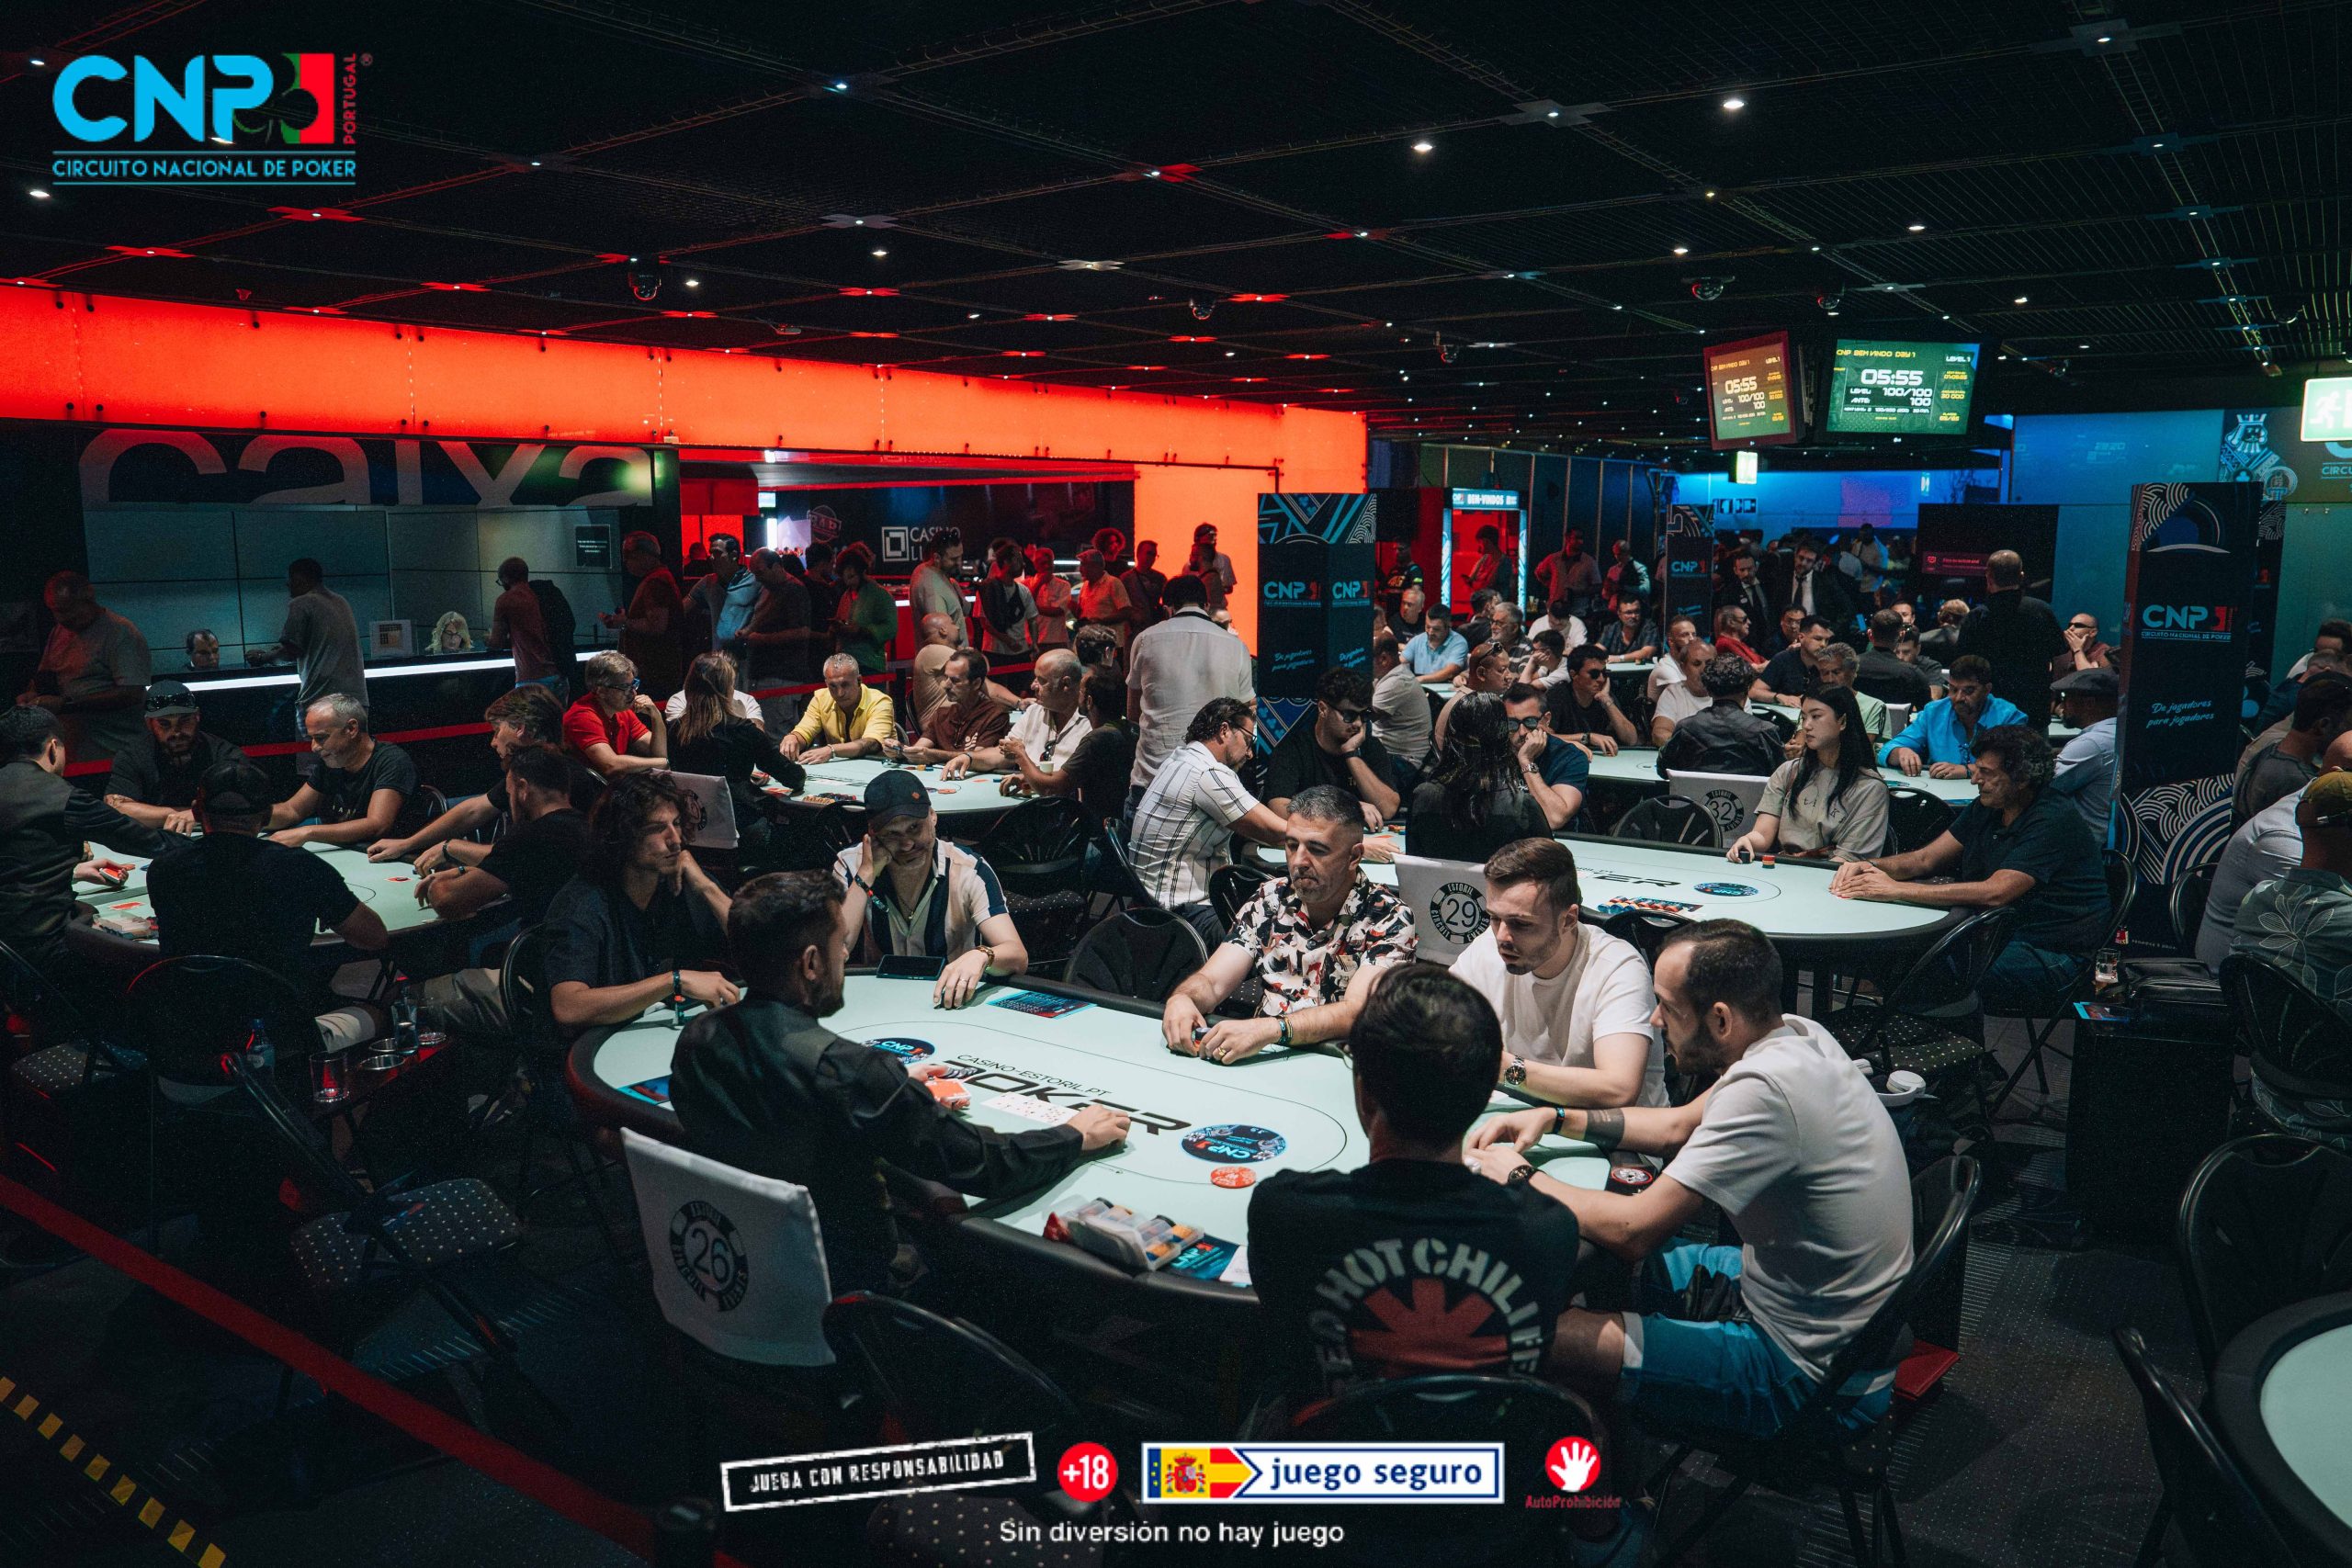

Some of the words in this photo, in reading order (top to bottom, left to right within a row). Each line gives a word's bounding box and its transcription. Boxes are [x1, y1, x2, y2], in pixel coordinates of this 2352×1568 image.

[1724, 376, 1758, 395] 05:55
[1860, 368, 1924, 386] 05:55
[1737, 391, 1765, 403] 100/100
[1883, 387, 1933, 397] 100/100
[1753, 400, 1766, 411] 100
[1909, 397, 1932, 407] 100
[1670, 560, 1698, 574] CNP
[1263, 581, 1306, 600] CNP
[1331, 581, 1362, 600] CNP
[2142, 604, 2209, 630] CNP
[2152, 703, 2166, 714] De
[2165, 699, 2212, 715] jogadores
[2145, 718, 2172, 729] para
[2169, 713, 2215, 728] jogadores
[1709, 800, 1733, 821] 32
[1447, 883, 1474, 896] ESTORIL
[1445, 897, 1477, 928] 29
[1430, 909, 1452, 938] CIRCUIT
[1466, 918, 1490, 942] EVENTS
[882, 1041, 914, 1051] CNP
[956, 1054, 1112, 1098] CASINO-ESTORIL.PT
[1207, 1145, 1250, 1159] CNP
[691, 1227, 730, 1284] 26
[1315, 1238, 1407, 1311] HOT
[1411, 1237, 1540, 1327] CHILI
